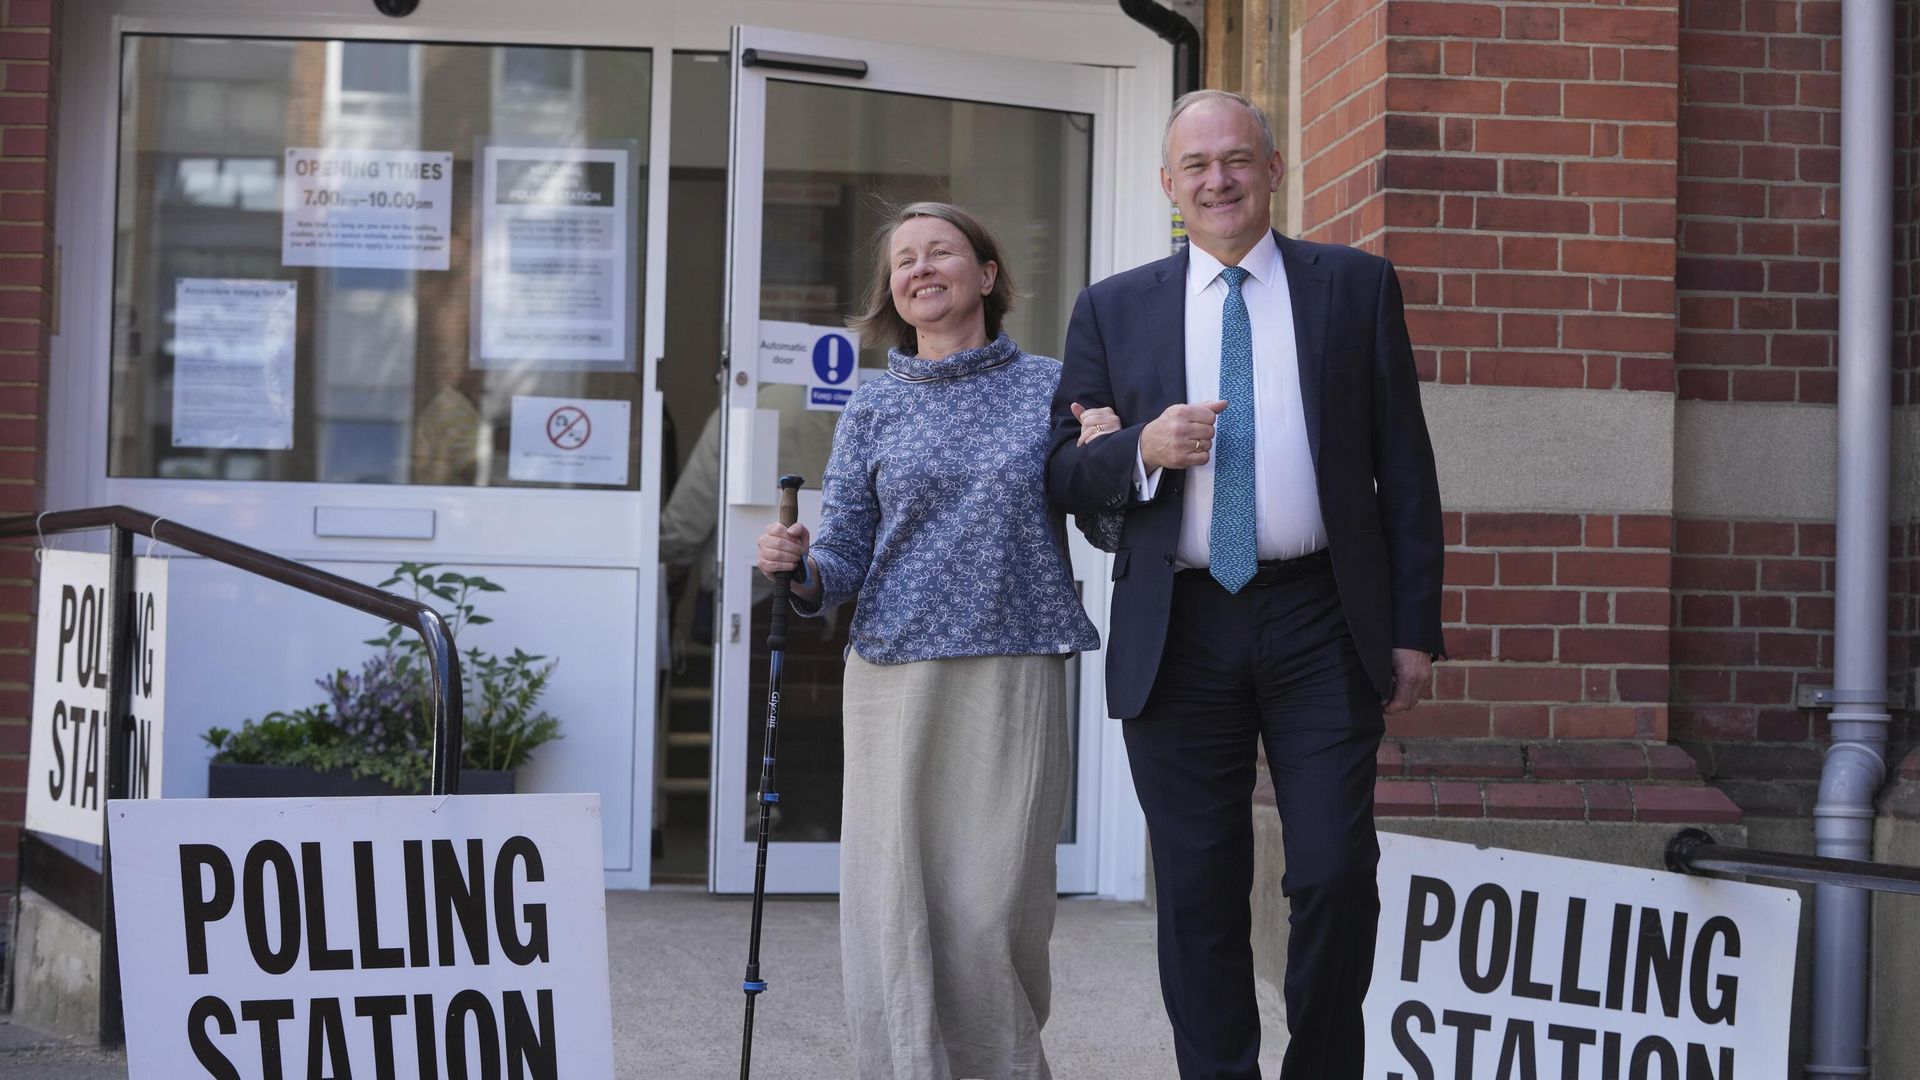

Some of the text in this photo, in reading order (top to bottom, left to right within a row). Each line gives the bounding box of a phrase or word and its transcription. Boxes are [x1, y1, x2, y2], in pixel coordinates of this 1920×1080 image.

[295, 159, 443, 180] OPENING TIMES
[760, 340, 807, 353] Automatic
[772, 354, 795, 365] door
[813, 390, 833, 402] Keep
[56, 584, 155, 699] POLNG
[49, 699, 152, 811] STAON
[179, 835, 550, 975] POLLING
[1400, 874, 1742, 1026] POLLING
[187, 989, 558, 1080] STATION
